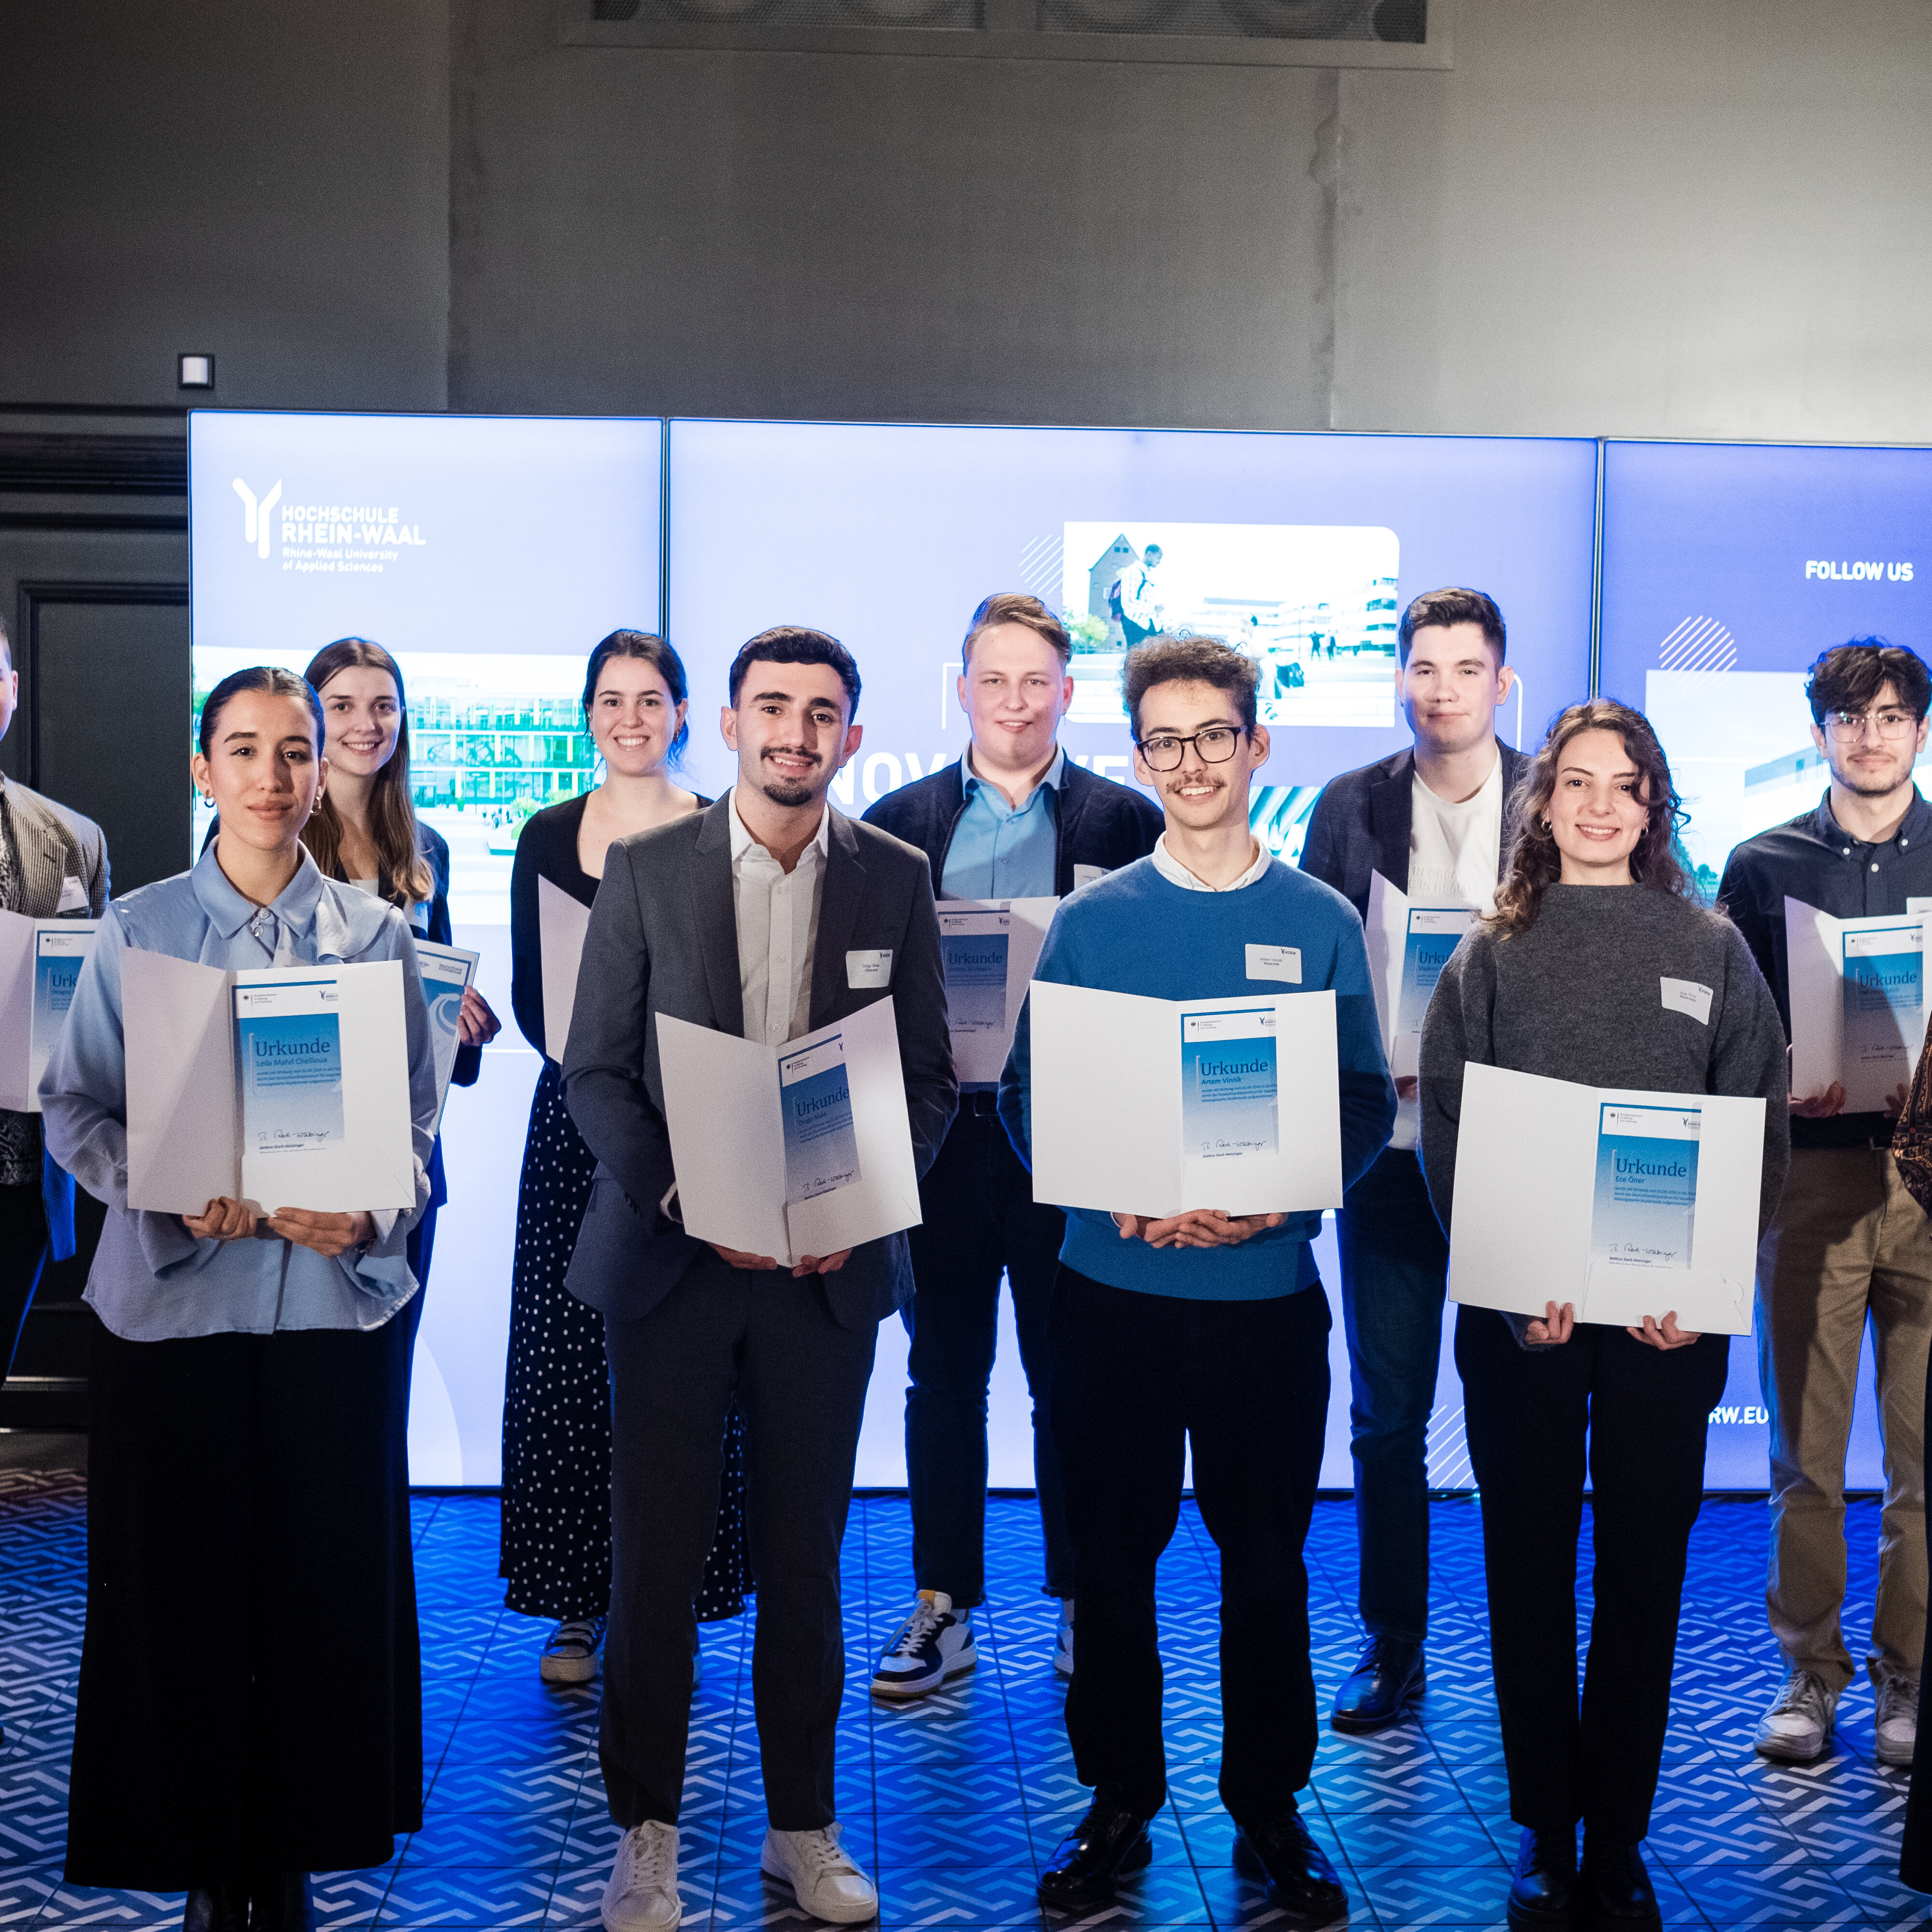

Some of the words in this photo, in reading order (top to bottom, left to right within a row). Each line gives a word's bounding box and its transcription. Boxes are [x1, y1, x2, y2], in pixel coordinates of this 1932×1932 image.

[282, 505, 398, 523] HOCHSCHULE
[282, 523, 426, 545] RHEIN-WAAL
[283, 547, 342, 559] Rhine-Waal
[345, 548, 398, 562] University
[283, 560, 293, 570] of
[295, 560, 335, 573] Applied
[337, 560, 384, 572] Sciences
[1805, 560, 1884, 581] FOLLOW
[1887, 562, 1914, 581] US
[949, 952, 1003, 964] Urkunde
[1861, 972, 1917, 986] Urkunde
[256, 1038, 330, 1056] Urkunde
[1201, 1059, 1268, 1076] Urkunde
[797, 1086, 850, 1118] Urkunde
[1616, 1158, 1686, 1177] Urkunde
